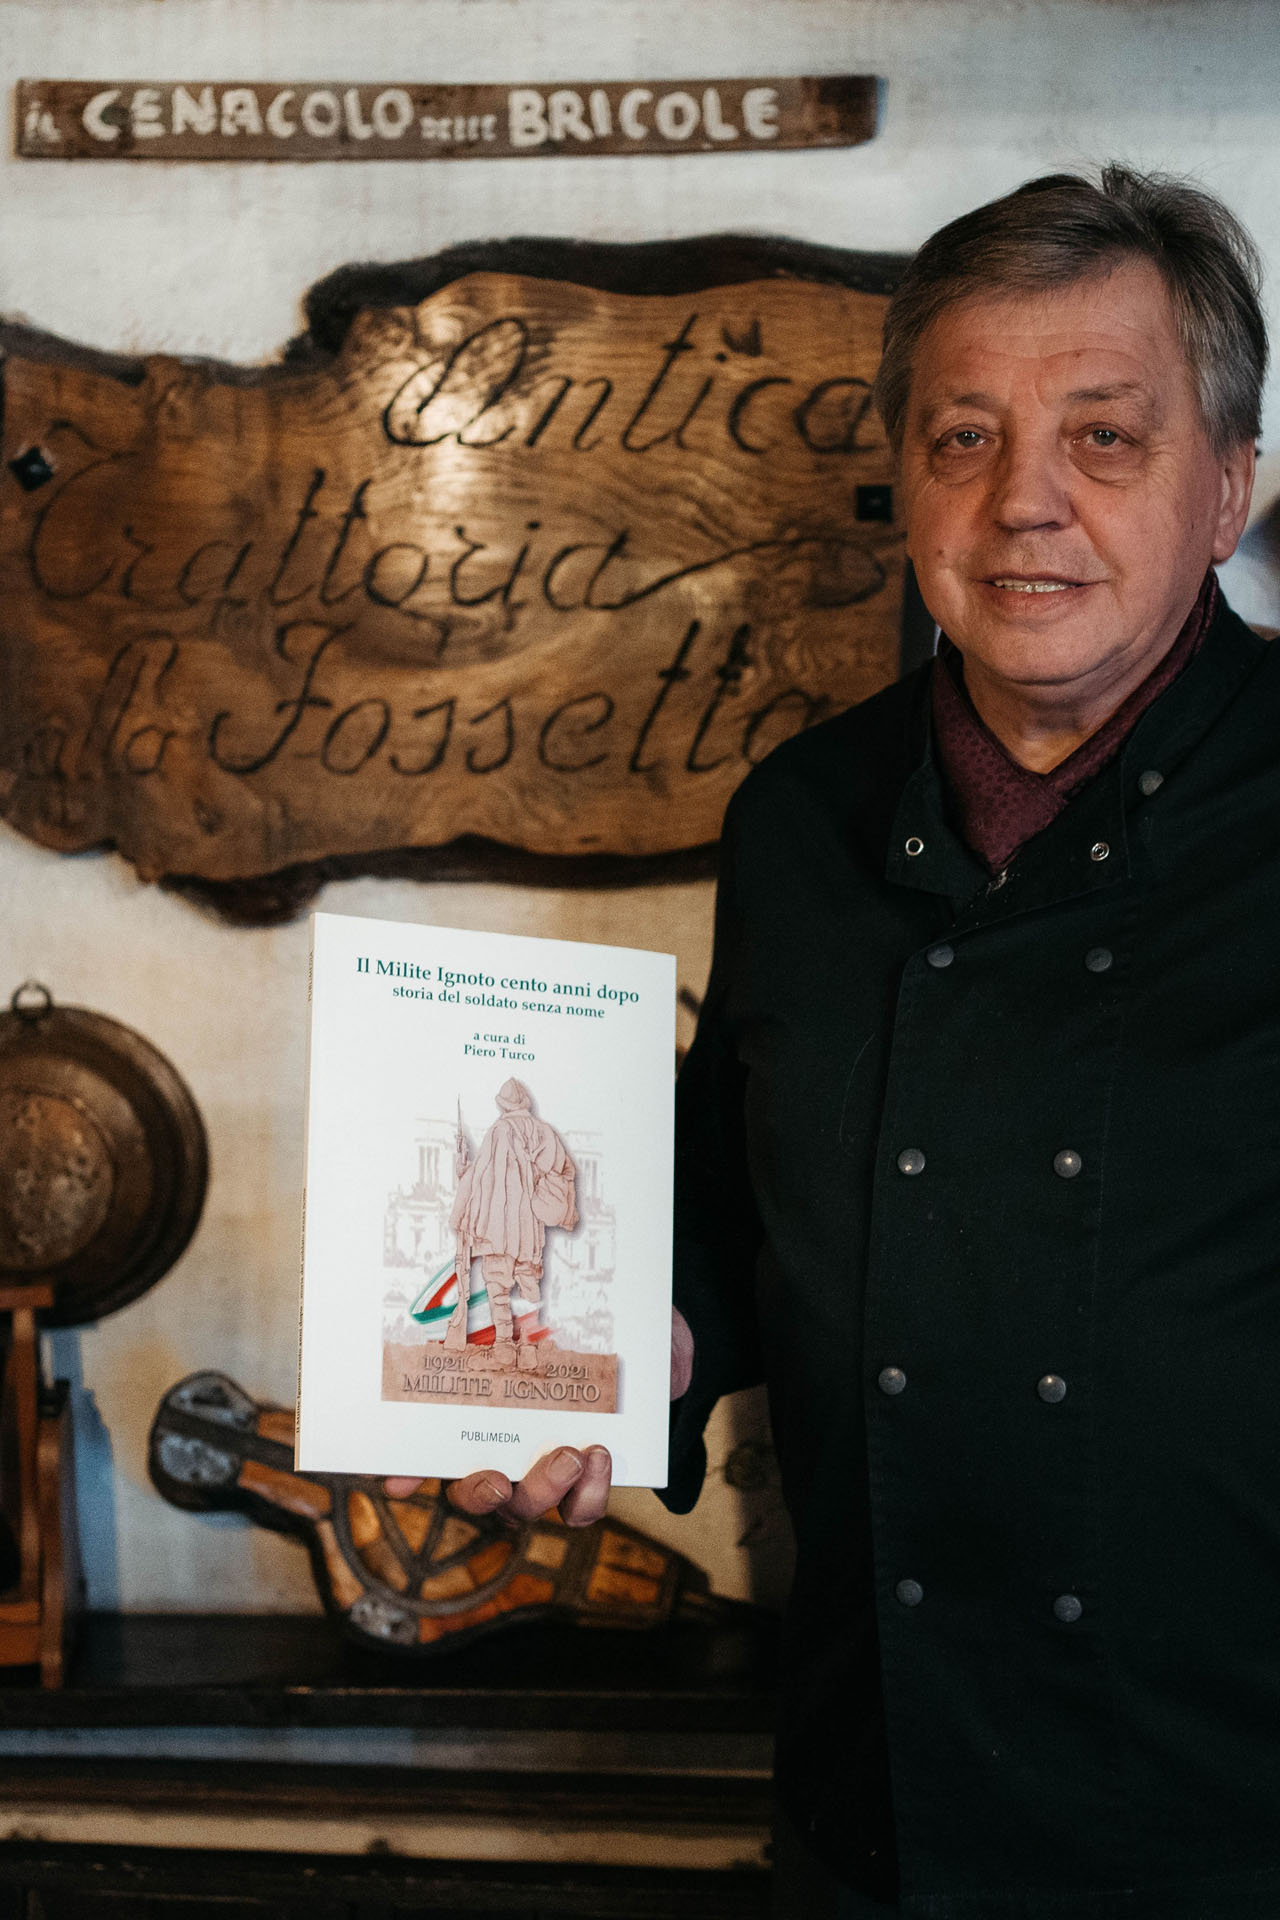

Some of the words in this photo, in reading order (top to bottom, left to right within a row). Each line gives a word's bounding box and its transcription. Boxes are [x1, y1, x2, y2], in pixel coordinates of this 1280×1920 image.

[82, 86, 414, 141] CENACOLO
[508, 87, 779, 147] BRICOLE
[382, 313, 877, 456] Antica
[28, 420, 650, 630] Trattoria
[356, 956, 370, 973] Il
[376, 960, 432, 981] Milite
[438, 967, 496, 988] Ignoto
[500, 976, 548, 994] cento
[553, 981, 591, 998] anni
[597, 984, 640, 1005] dopo
[392, 985, 434, 1001] storia
[438, 989, 461, 1004] del
[465, 993, 518, 1010] soldato
[522, 1001, 562, 1015] senza
[566, 1005, 606, 1019] nome
[464, 1044, 496, 1058] Piero
[500, 1047, 535, 1062] Turco
[473, 1032, 480, 1041] a
[483, 1033, 510, 1044] cura
[514, 1033, 526, 1046] di
[424, 1354, 467, 1373] 1921
[545, 1363, 589, 1381] 2021
[403, 1374, 493, 1397] MILITE
[504, 1379, 602, 1402] IGNOTO
[460, 1430, 521, 1444] PUBLIMEDIA
